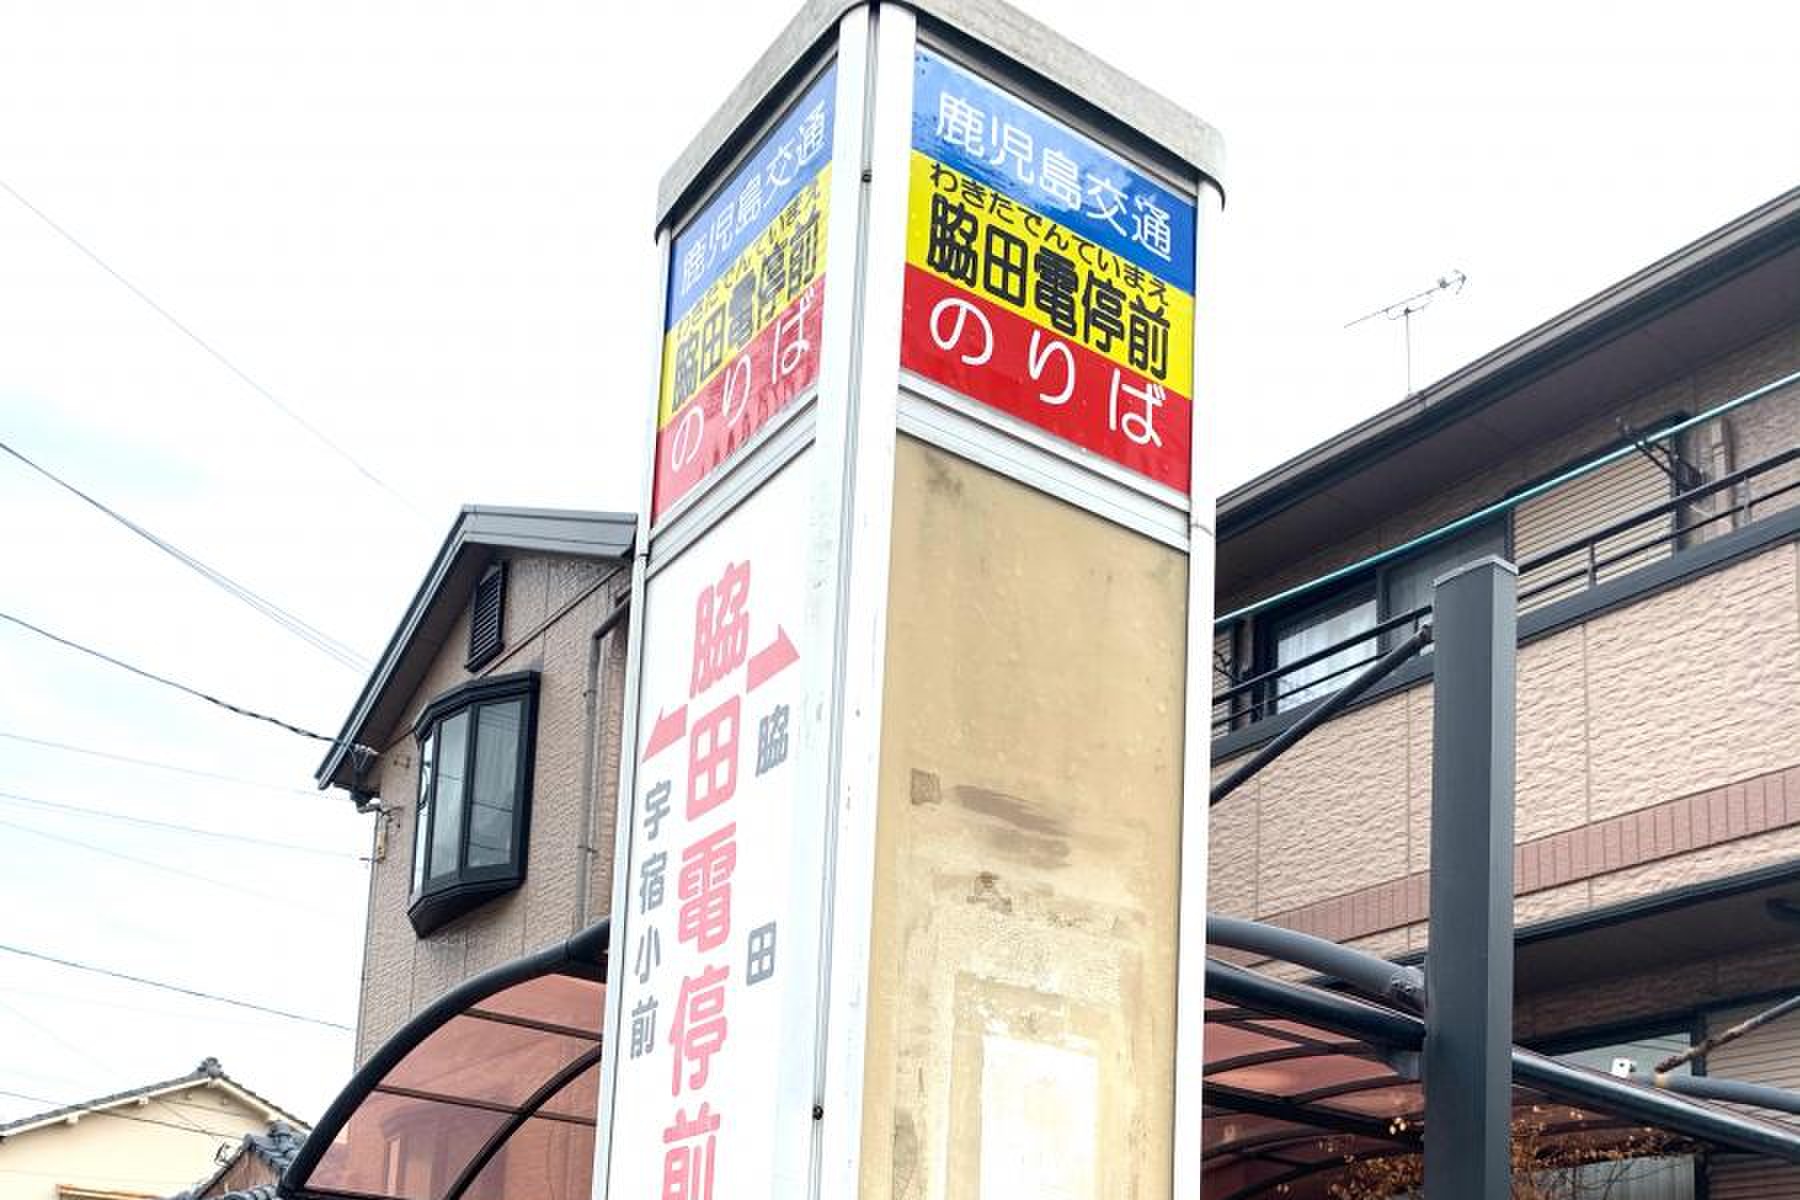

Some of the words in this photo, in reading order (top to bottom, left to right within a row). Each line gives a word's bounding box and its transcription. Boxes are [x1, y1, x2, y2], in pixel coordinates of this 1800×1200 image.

[930, 162, 1169, 306] わきたでんていまえ
[935, 88, 1173, 262] 鹿児島交通
[671, 205, 821, 411] 脇田電停前
[672, 287, 816, 473] のりば
[926, 193, 1172, 381] 脇田電停前
[929, 296, 1164, 447] のりば
[630, 779, 672, 1060] 宇宿小前
